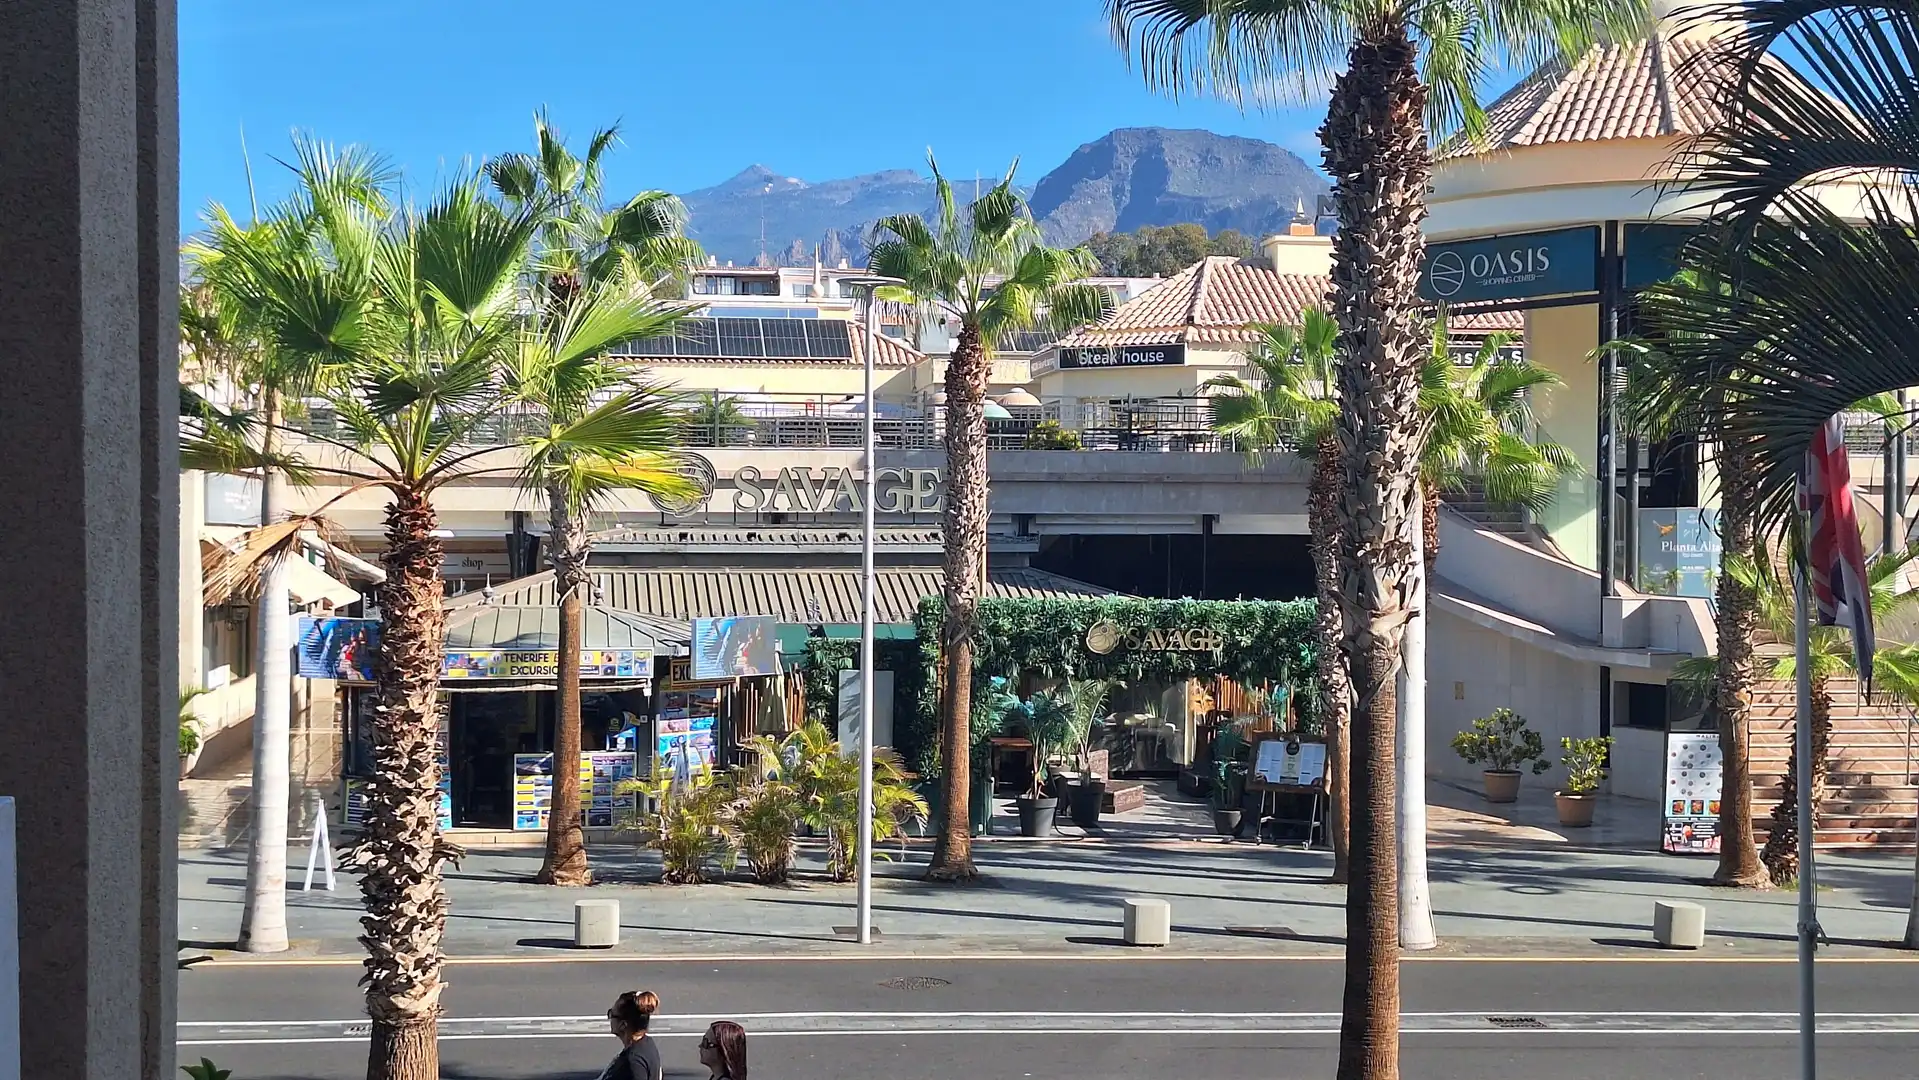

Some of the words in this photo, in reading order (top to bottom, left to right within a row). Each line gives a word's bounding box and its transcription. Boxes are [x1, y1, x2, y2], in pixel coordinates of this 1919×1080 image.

[1470, 247, 1550, 277] OASIS
[1482, 277, 1512, 286] SHOPPING
[1513, 274, 1536, 283] CENTER
[1079, 353, 1117, 365] Steak
[1122, 351, 1164, 363] house
[733, 465, 943, 513] SAVAGE
[1661, 541, 1697, 552] Planta
[461, 557, 484, 570] shop
[1125, 627, 1223, 651] SAVAGE
[504, 653, 549, 662] TENERIFE
[510, 665, 559, 675] EXCURSIO
